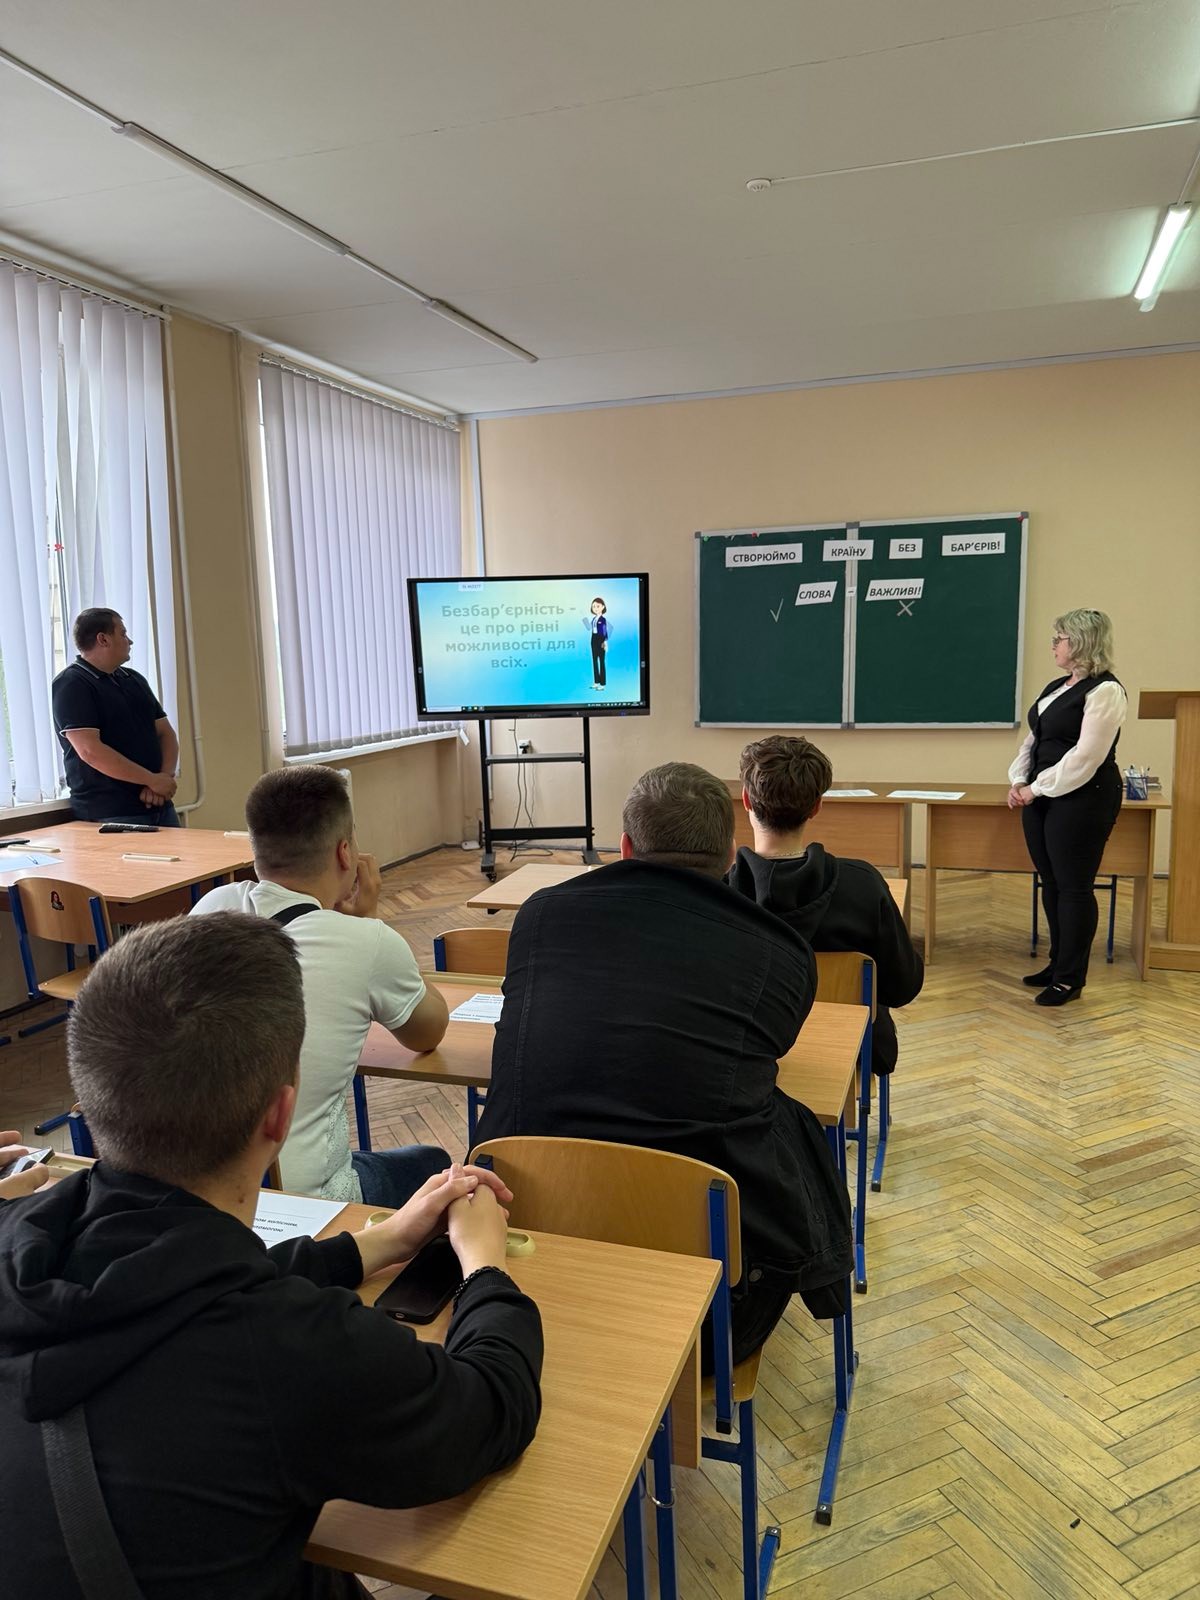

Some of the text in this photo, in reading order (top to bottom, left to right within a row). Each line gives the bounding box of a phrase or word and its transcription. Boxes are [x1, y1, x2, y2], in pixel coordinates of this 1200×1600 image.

[733, 550, 796, 563] СТВОРЮЙМО
[831, 545, 867, 557] КРАЇНУ
[898, 543, 917, 553] БЕЗ
[799, 589, 832, 600] СЛОВА
[869, 586, 923, 598] ВАЖЛИВІ!
[460, 620, 560, 636] це про рівні
[445, 639, 576, 653] можливості для
[491, 656, 528, 669] всіх.
